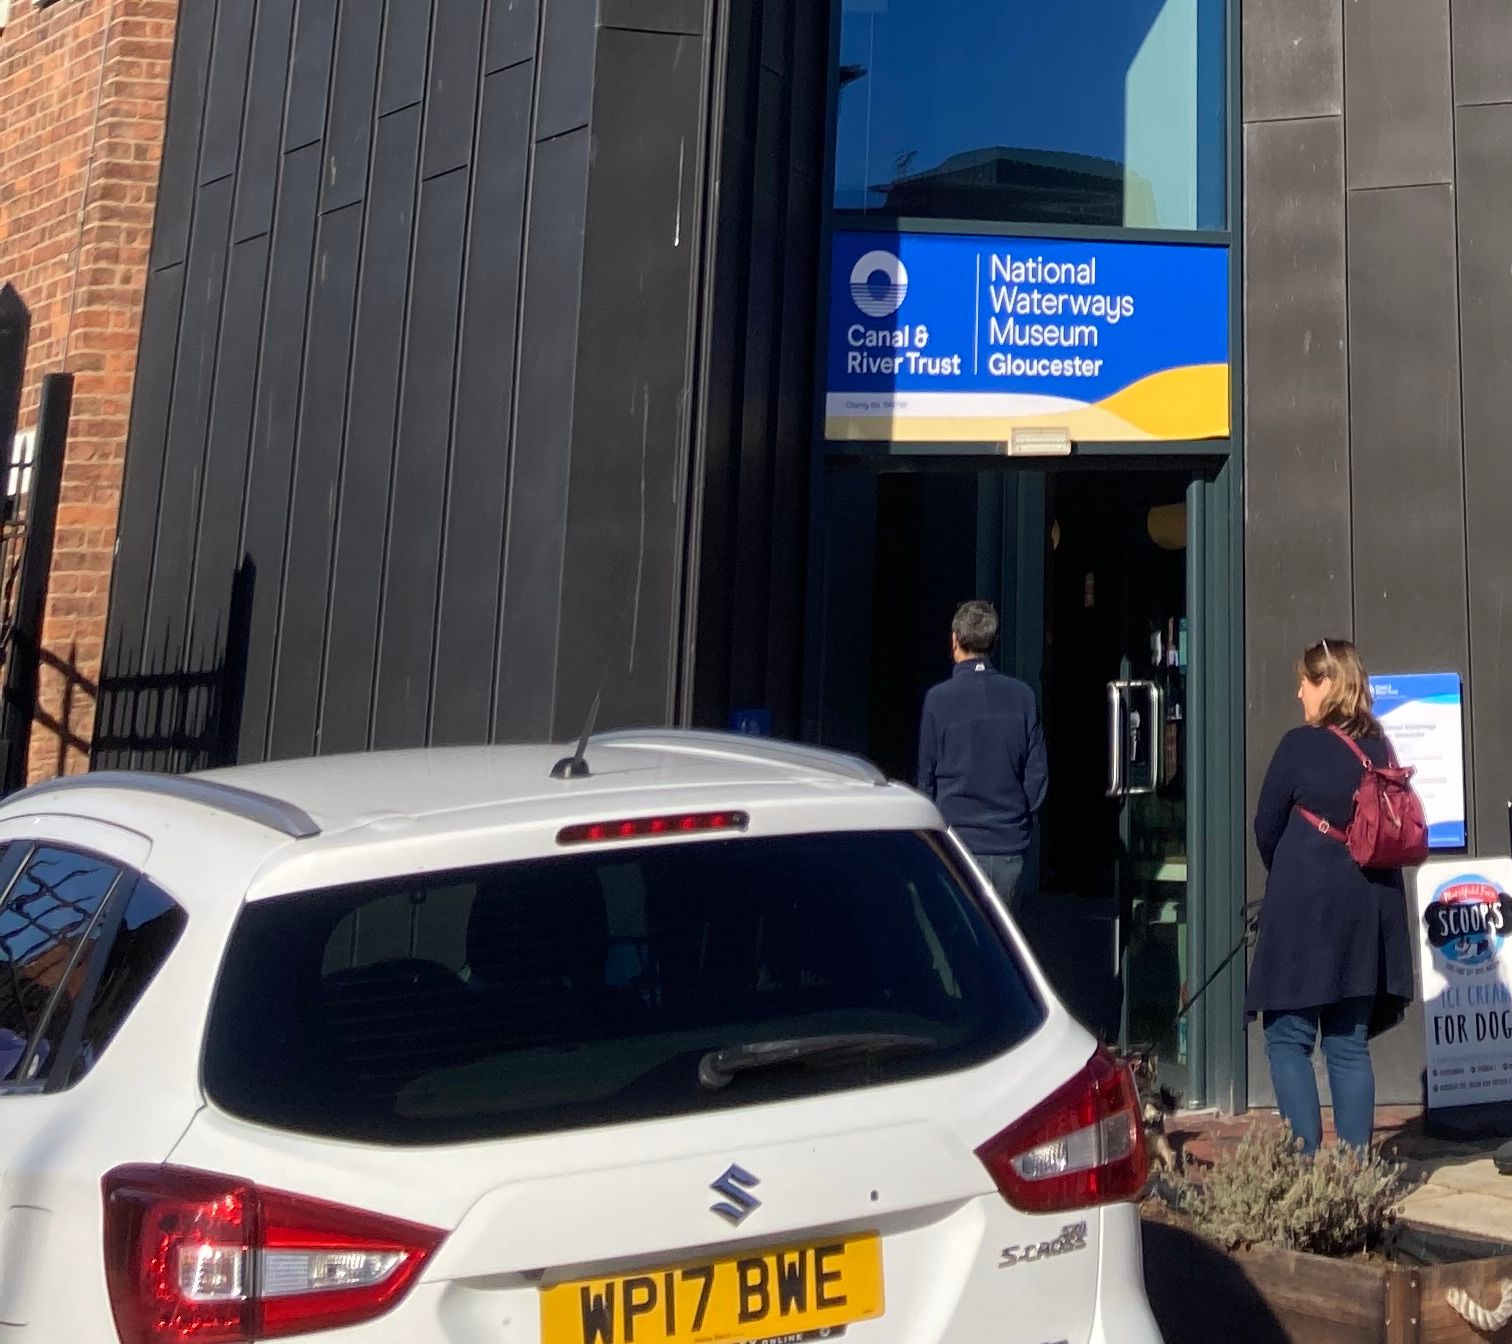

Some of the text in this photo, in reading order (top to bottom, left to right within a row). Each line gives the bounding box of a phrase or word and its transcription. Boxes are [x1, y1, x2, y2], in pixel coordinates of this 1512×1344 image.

[989, 253, 1096, 285] National
[988, 284, 1135, 323] Waterways
[847, 324, 929, 348] Canal &
[988, 316, 1099, 348] Museum
[847, 352, 961, 376] River Trust
[988, 353, 1103, 377] Gloucester
[1433, 1015, 1470, 1045] FOR
[580, 1243, 848, 1344] WP17 BWE
